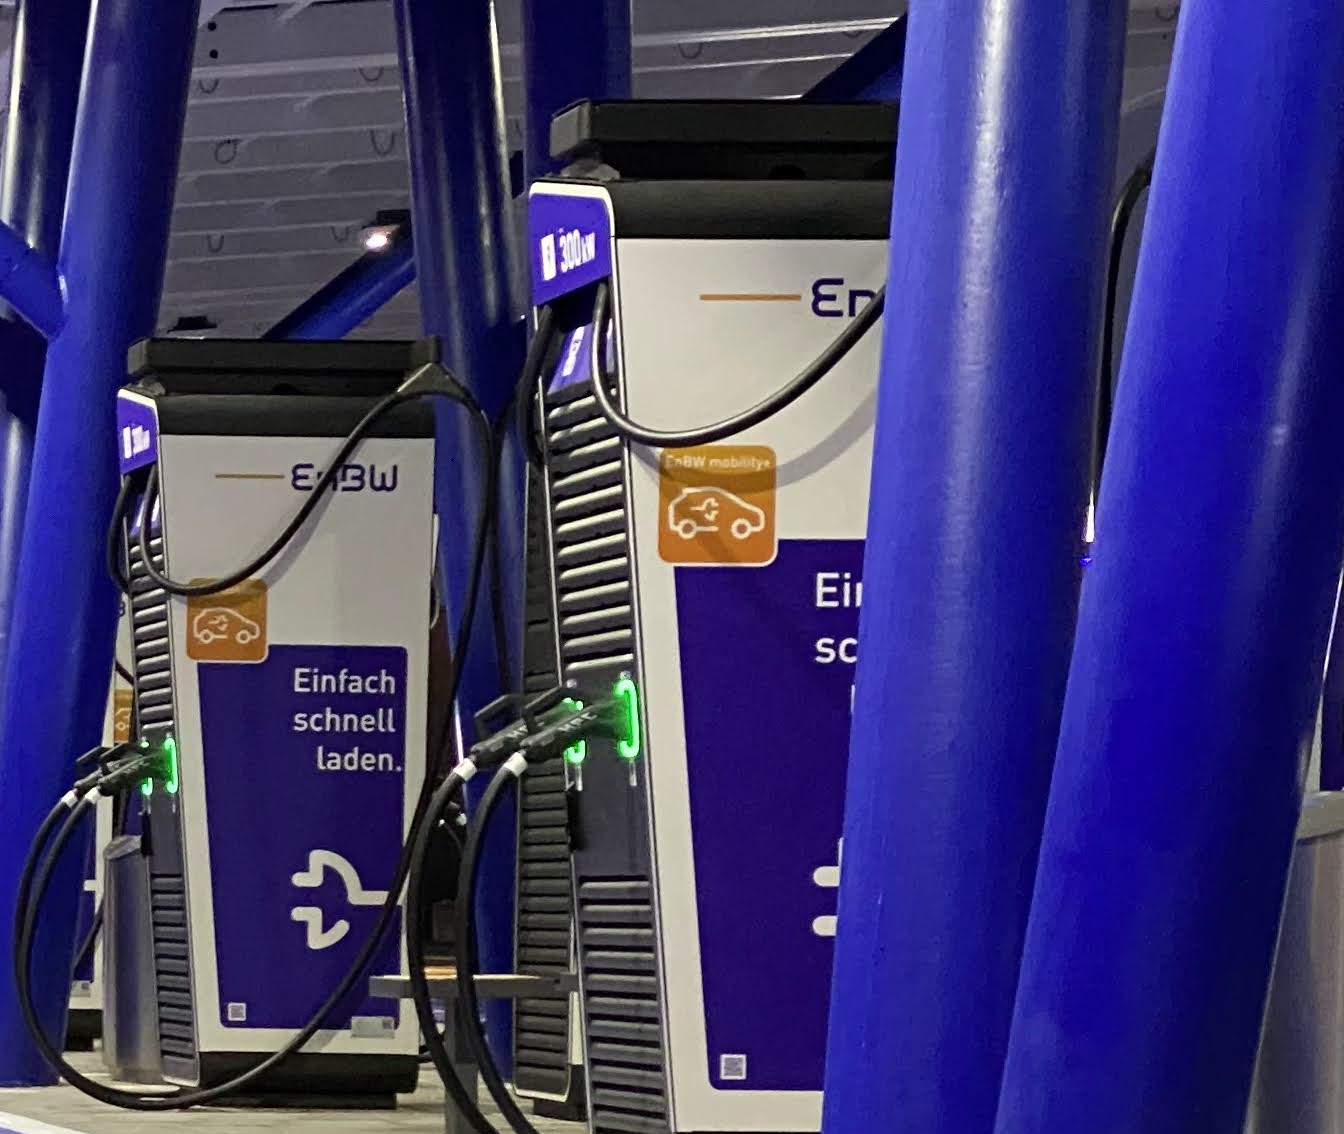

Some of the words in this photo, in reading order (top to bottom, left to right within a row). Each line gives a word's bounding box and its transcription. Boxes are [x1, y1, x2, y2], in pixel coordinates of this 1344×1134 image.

[293, 667, 396, 694] Einfach
[293, 706, 396, 733] schnell
[316, 745, 403, 772] laden.
